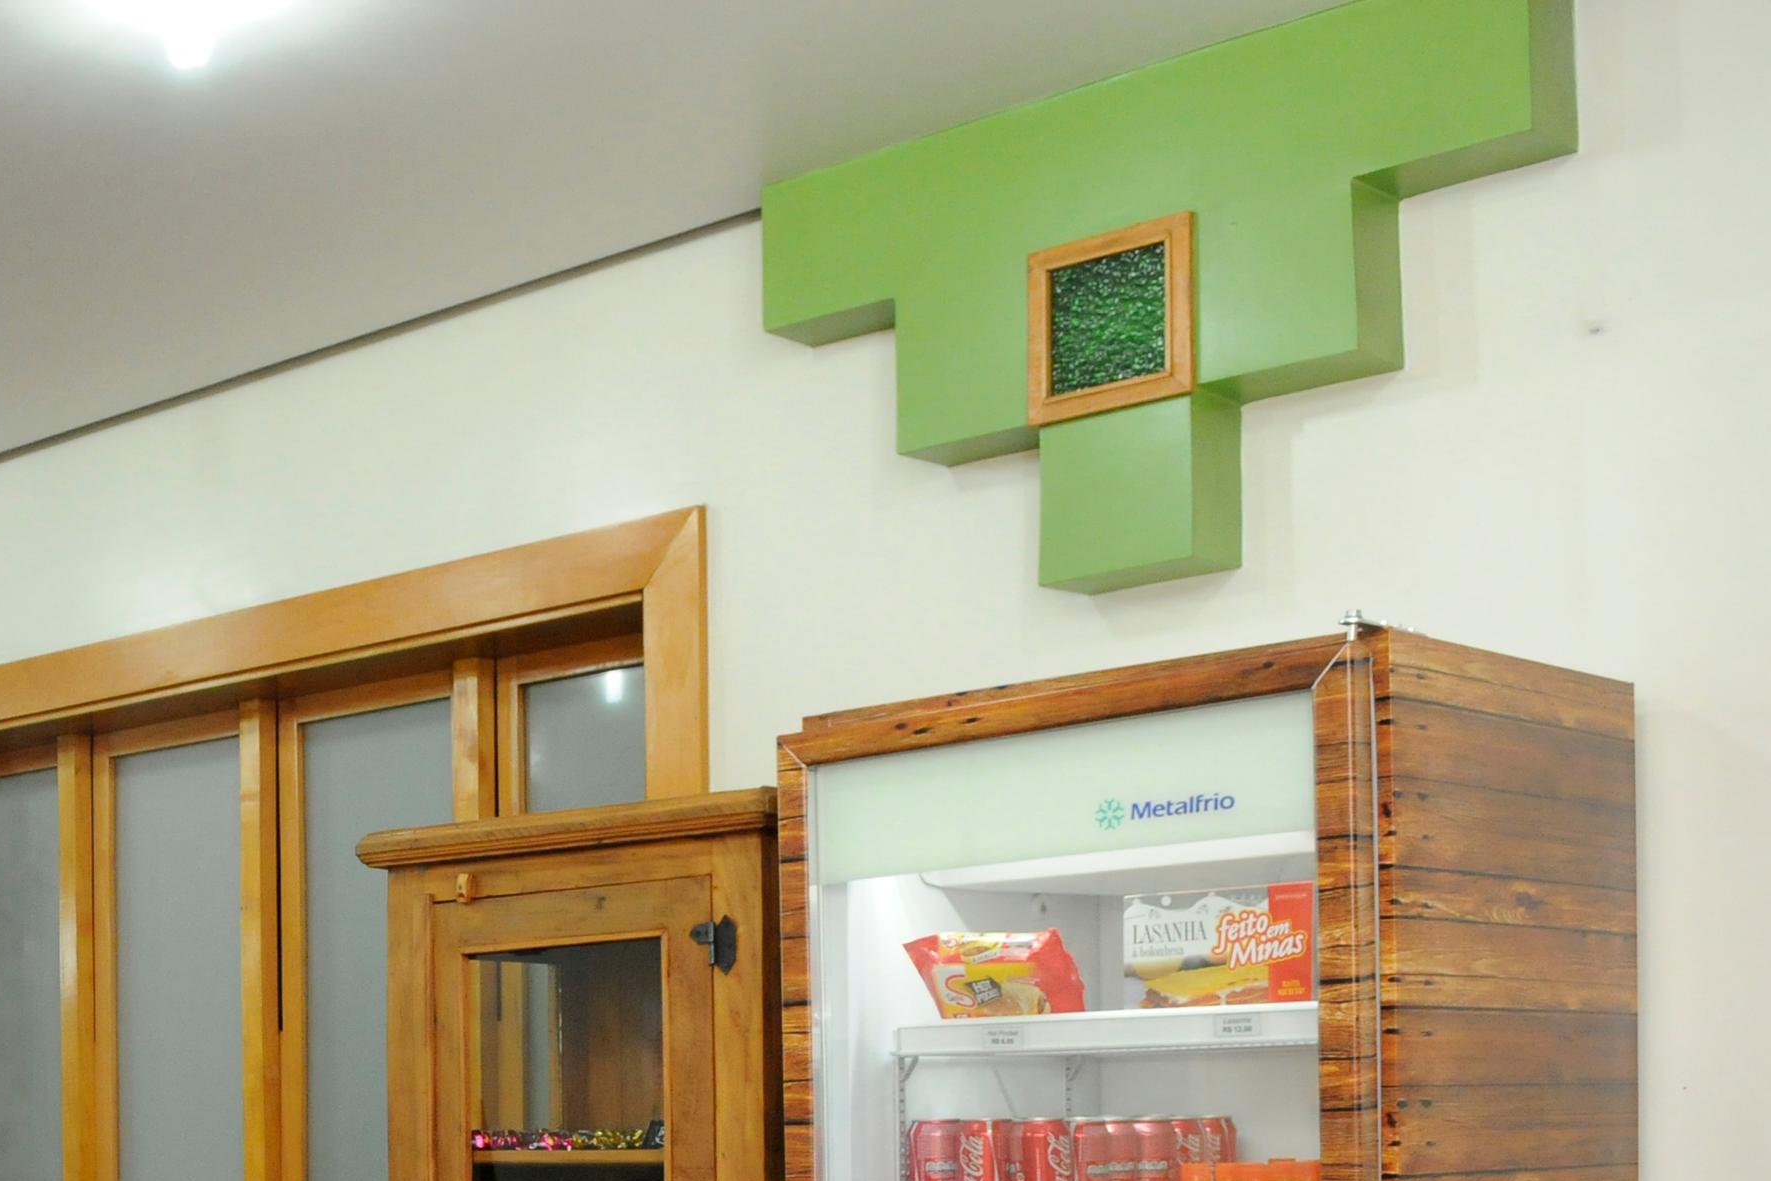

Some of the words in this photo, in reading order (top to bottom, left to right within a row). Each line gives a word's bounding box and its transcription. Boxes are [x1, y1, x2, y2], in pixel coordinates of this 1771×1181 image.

[1130, 793, 1235, 820] Metalfrio
[1132, 921, 1208, 945] LASANHA
[1213, 911, 1269, 954] feito
[1267, 921, 1290, 938] em
[1229, 932, 1304, 969] Minas
